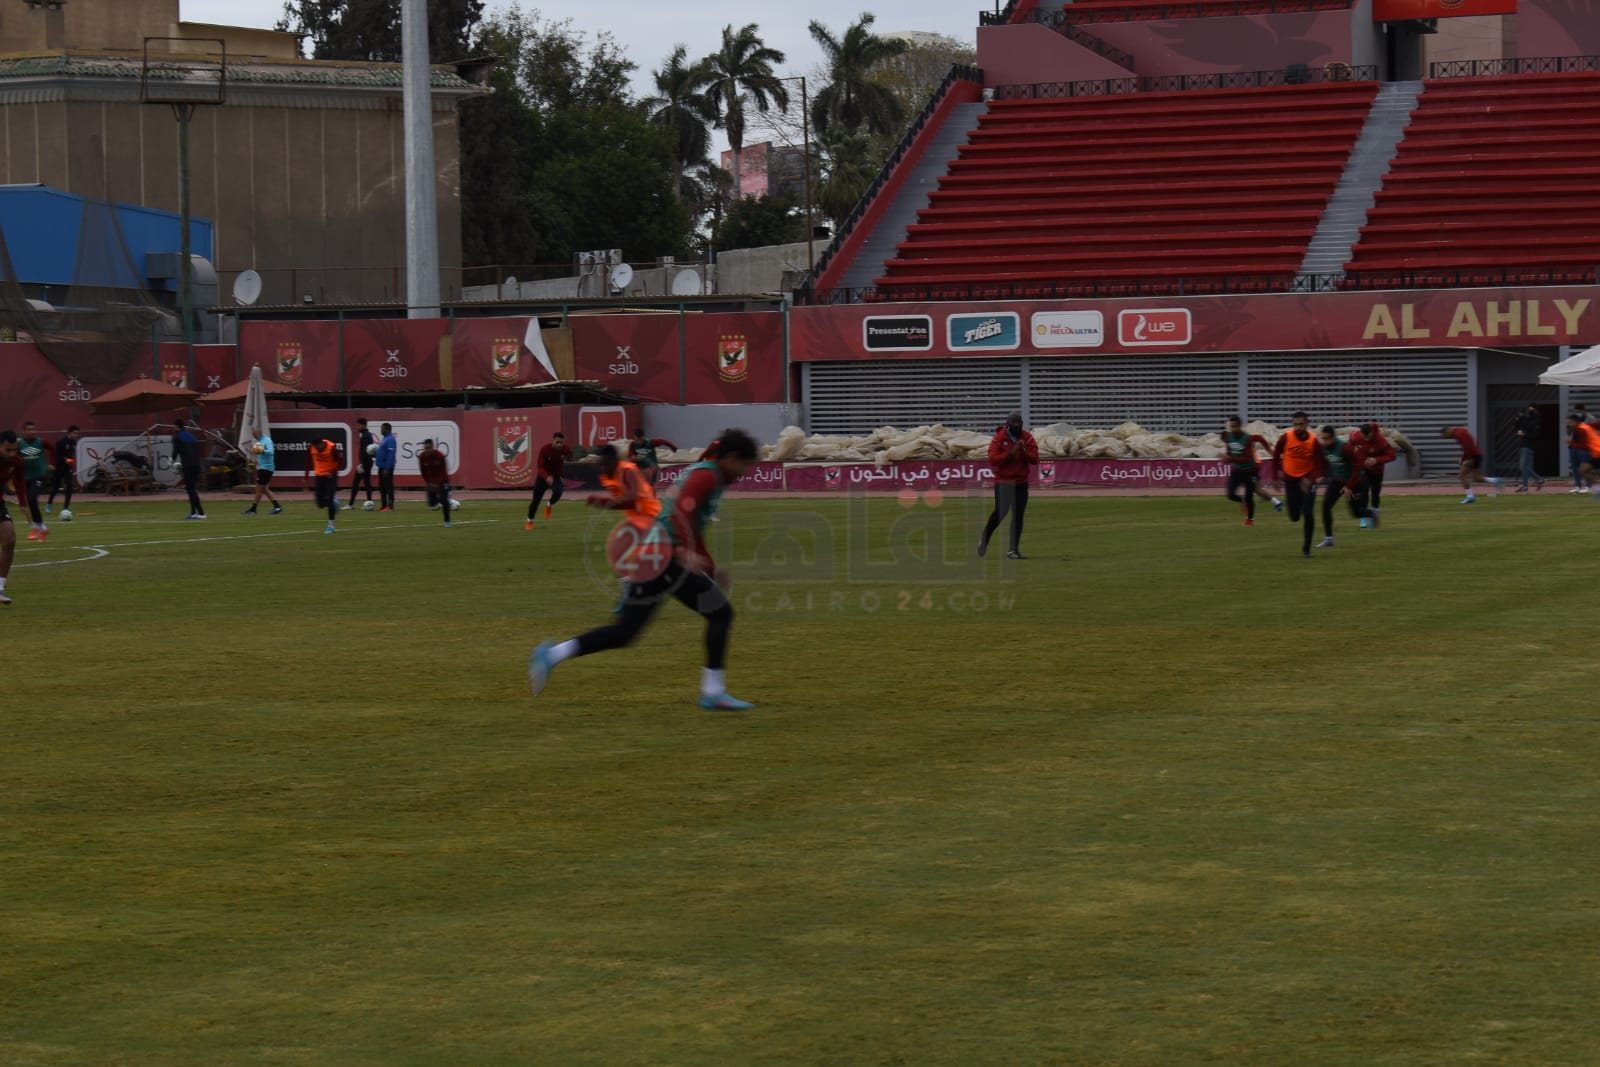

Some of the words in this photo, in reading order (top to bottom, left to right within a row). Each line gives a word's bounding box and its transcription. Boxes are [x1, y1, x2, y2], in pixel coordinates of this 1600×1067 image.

[1362, 303, 1431, 340] AL
[1446, 299, 1592, 338] AHLY
[964, 322, 1003, 344] TIGER
[378, 365, 408, 378] saib
[608, 363, 640, 376] saib
[58, 387, 92, 402] saib
[753, 466, 783, 483] تاريخ
[849, 464, 899, 483] الكون
[901, 465, 930, 486] في
[935, 464, 974, 485] نادي
[1100, 464, 1150, 480] الجميع
[1151, 463, 1184, 481] فوق
[1185, 464, 1232, 484] الأهلي
